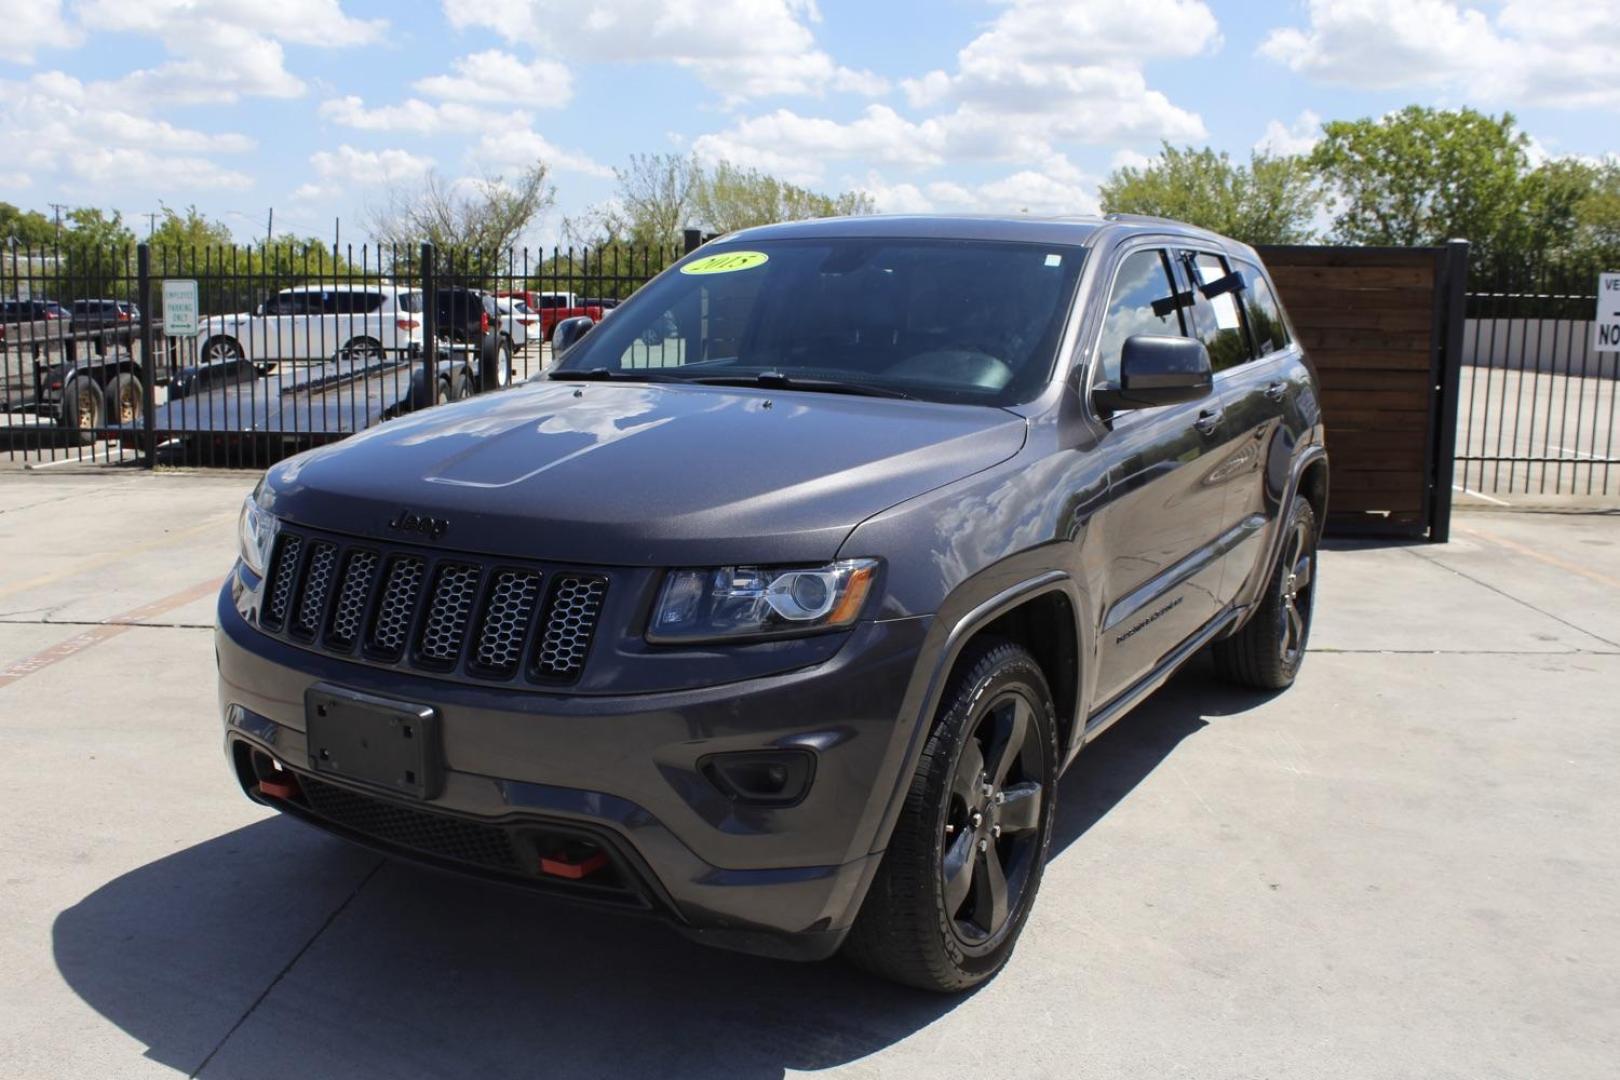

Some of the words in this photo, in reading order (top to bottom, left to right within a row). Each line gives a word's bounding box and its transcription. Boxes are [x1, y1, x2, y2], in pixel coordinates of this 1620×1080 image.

[168, 304, 193, 312] PARKING
[173, 313, 188, 322] ONLY
[388, 509, 450, 541] Jeep
